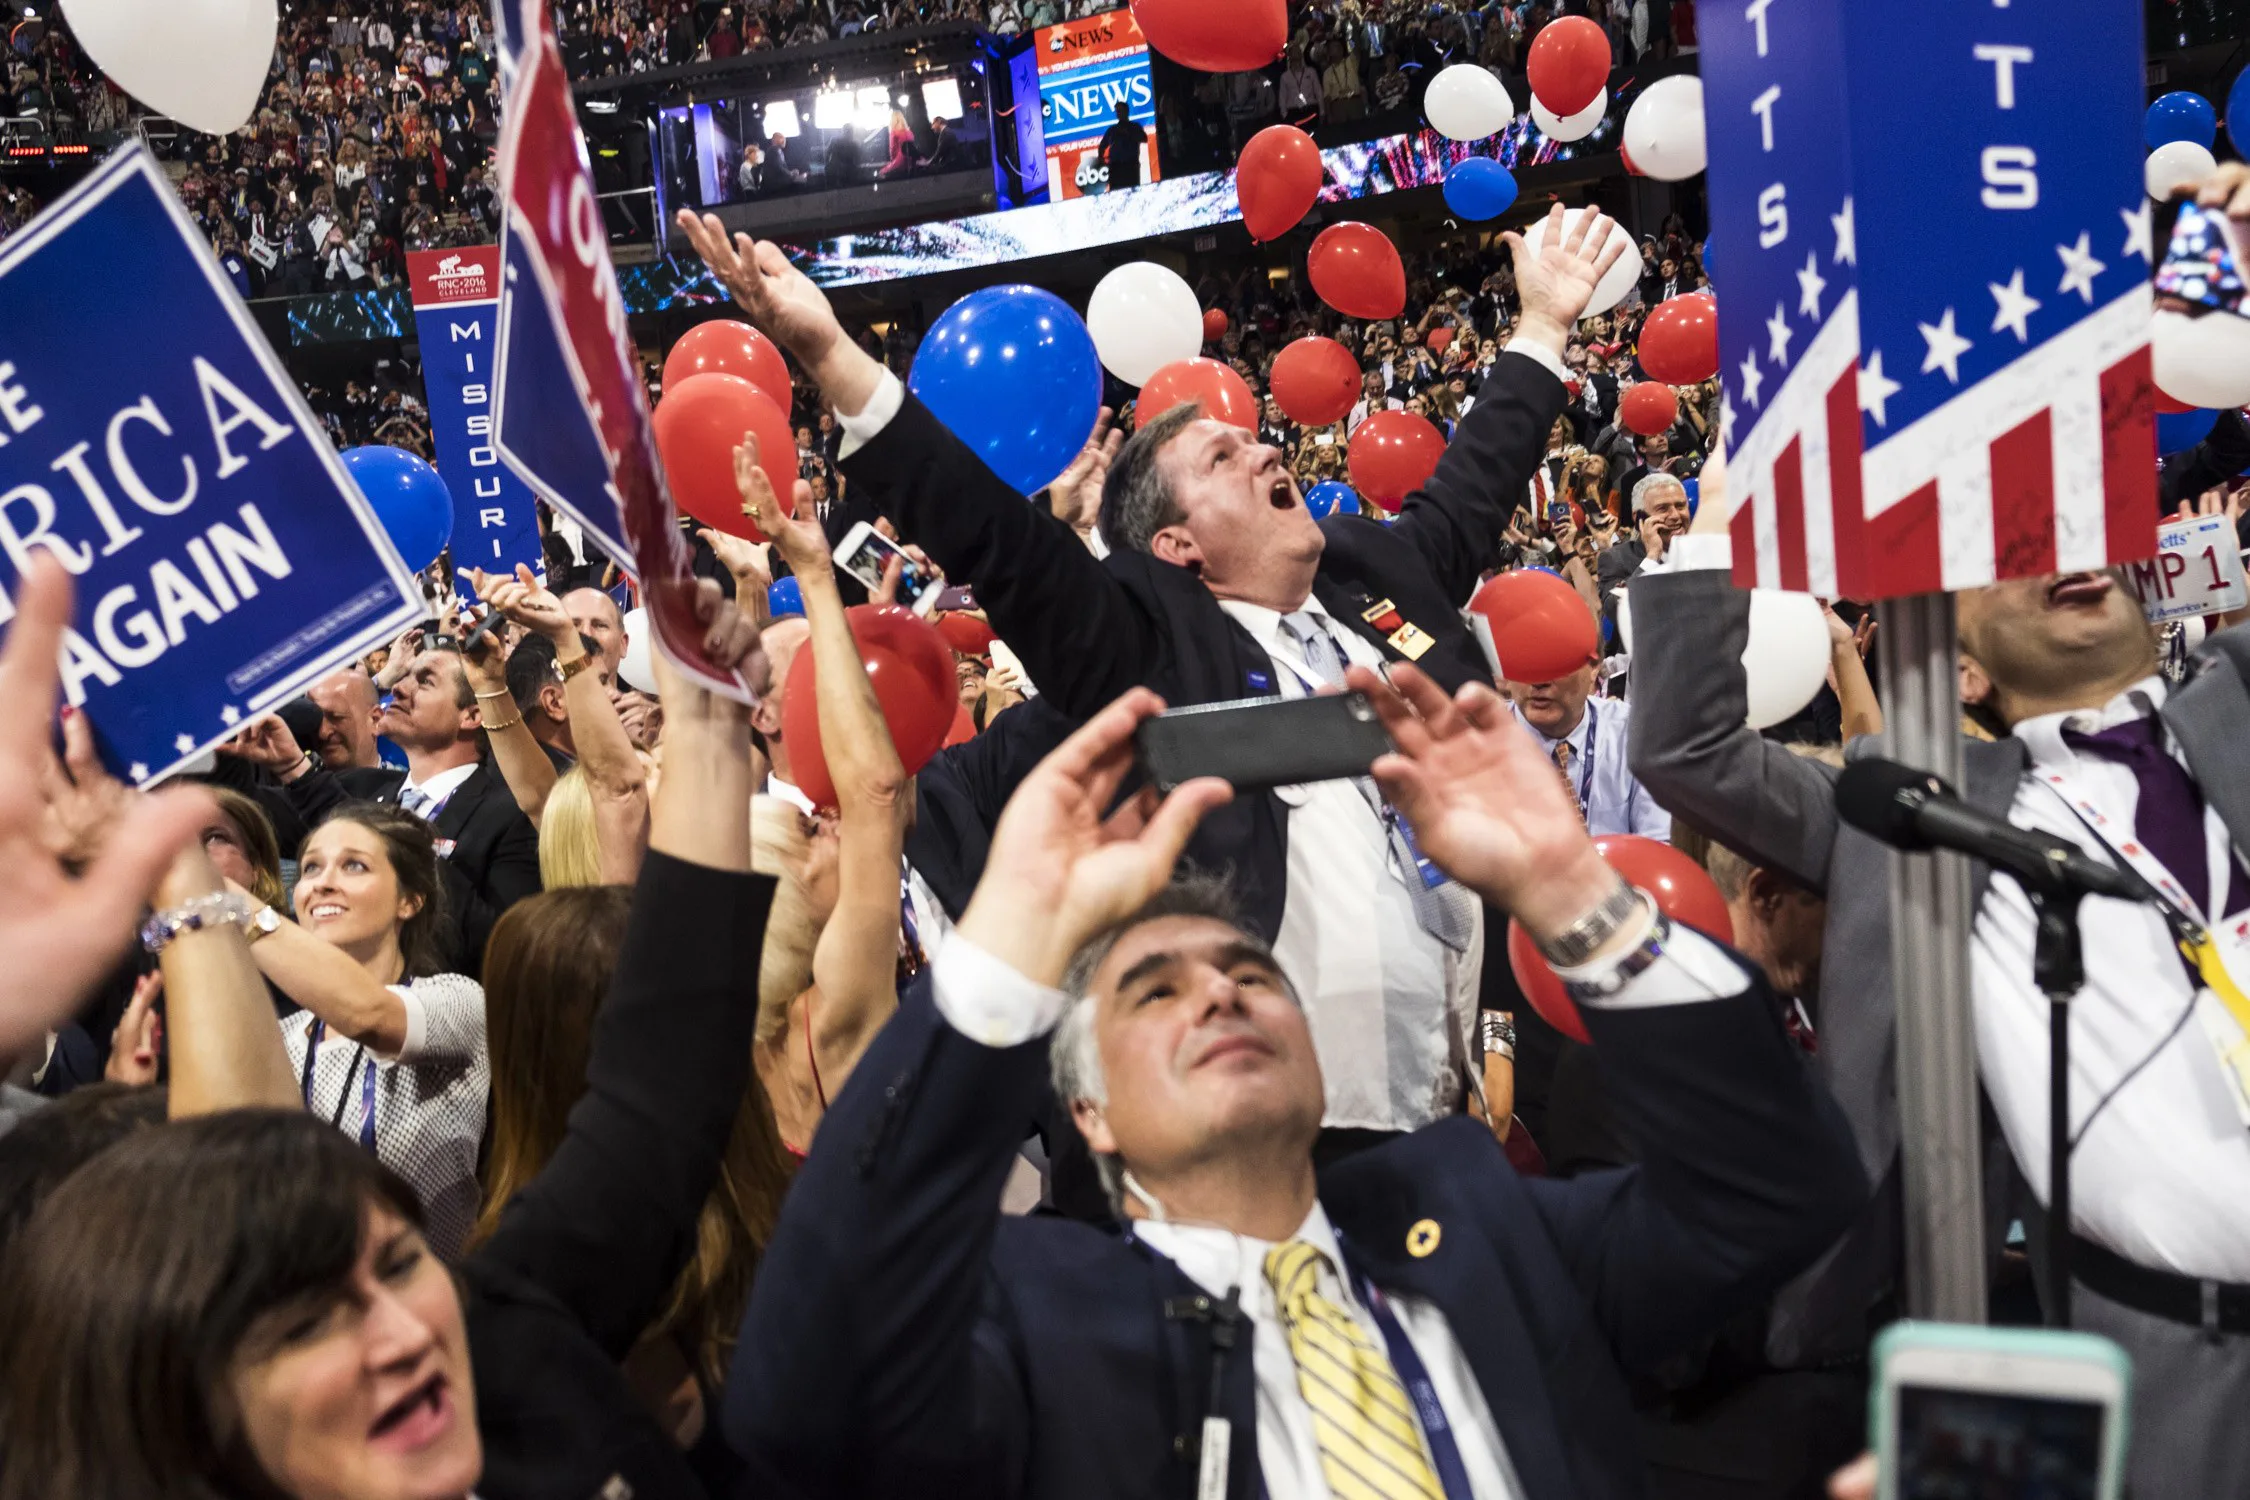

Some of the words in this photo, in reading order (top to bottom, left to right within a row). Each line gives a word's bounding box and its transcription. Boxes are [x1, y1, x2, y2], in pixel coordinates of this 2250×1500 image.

[1064, 26, 1114, 51] NEWS
[1051, 74, 1152, 125] NEWS
[1972, 0, 2040, 211] TS
[1075, 166, 1109, 187] abc
[439, 286, 487, 297] CLEVELAND
[450, 320, 507, 558] MISSOURI
[0, 355, 294, 622] RICA
[2157, 532, 2188, 549] etts
[2122, 552, 2186, 604] MP
[2202, 545, 2232, 591] 1
[57, 502, 293, 706] AGAIN
